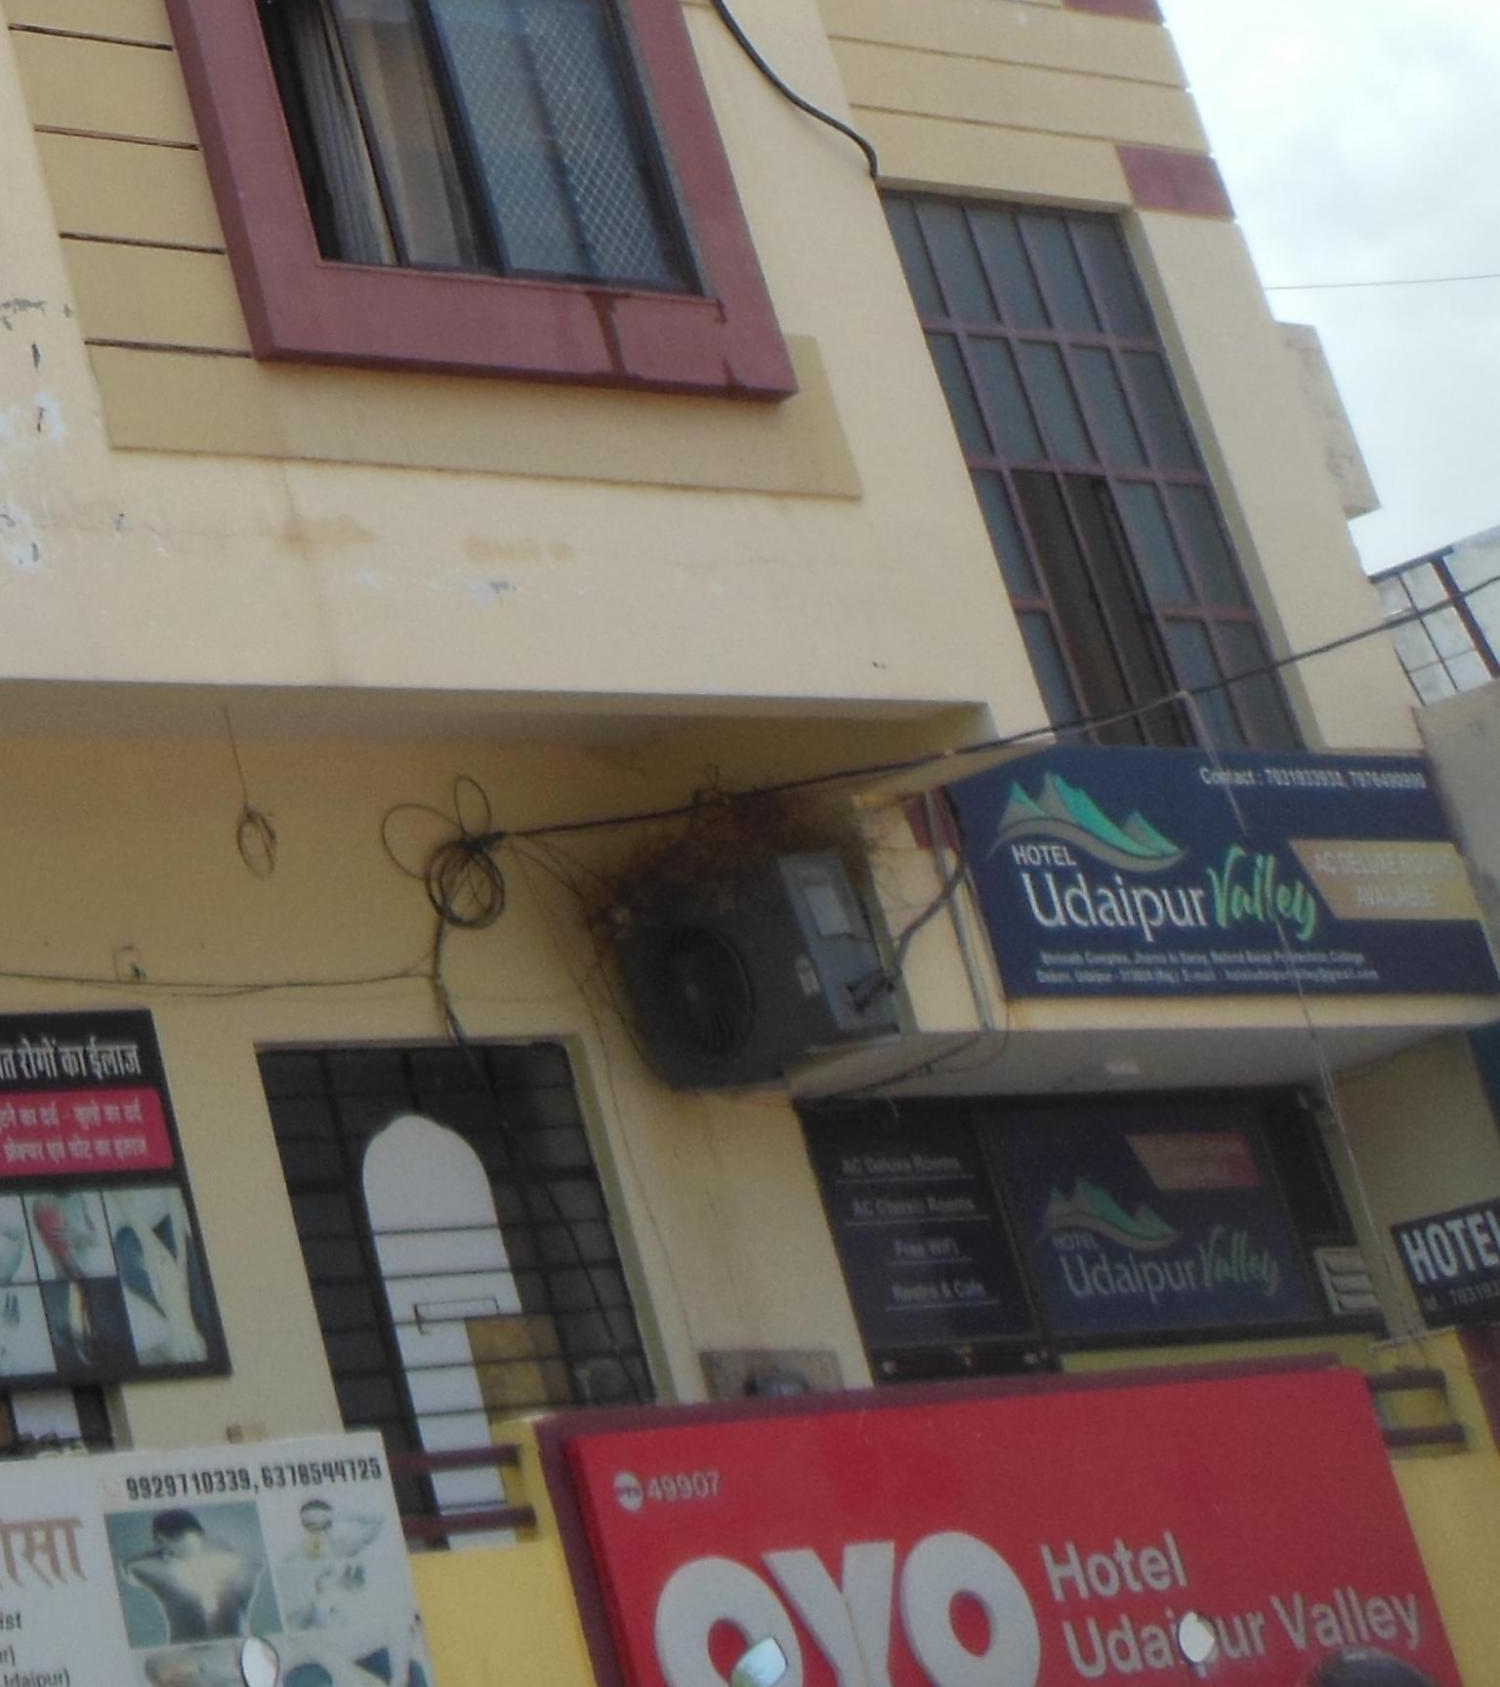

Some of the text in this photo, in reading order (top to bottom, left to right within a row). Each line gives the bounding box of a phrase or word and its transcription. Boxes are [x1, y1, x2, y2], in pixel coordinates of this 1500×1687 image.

[1012, 844, 1077, 866] HOTEL
[1021, 844, 1316, 943] Udaipur Valley
[648, 1469, 719, 1501] 49907
[1040, 1530, 1187, 1602] Hotel
[655, 1531, 1042, 1687] OYO
[1270, 1586, 1420, 1650] Valley
